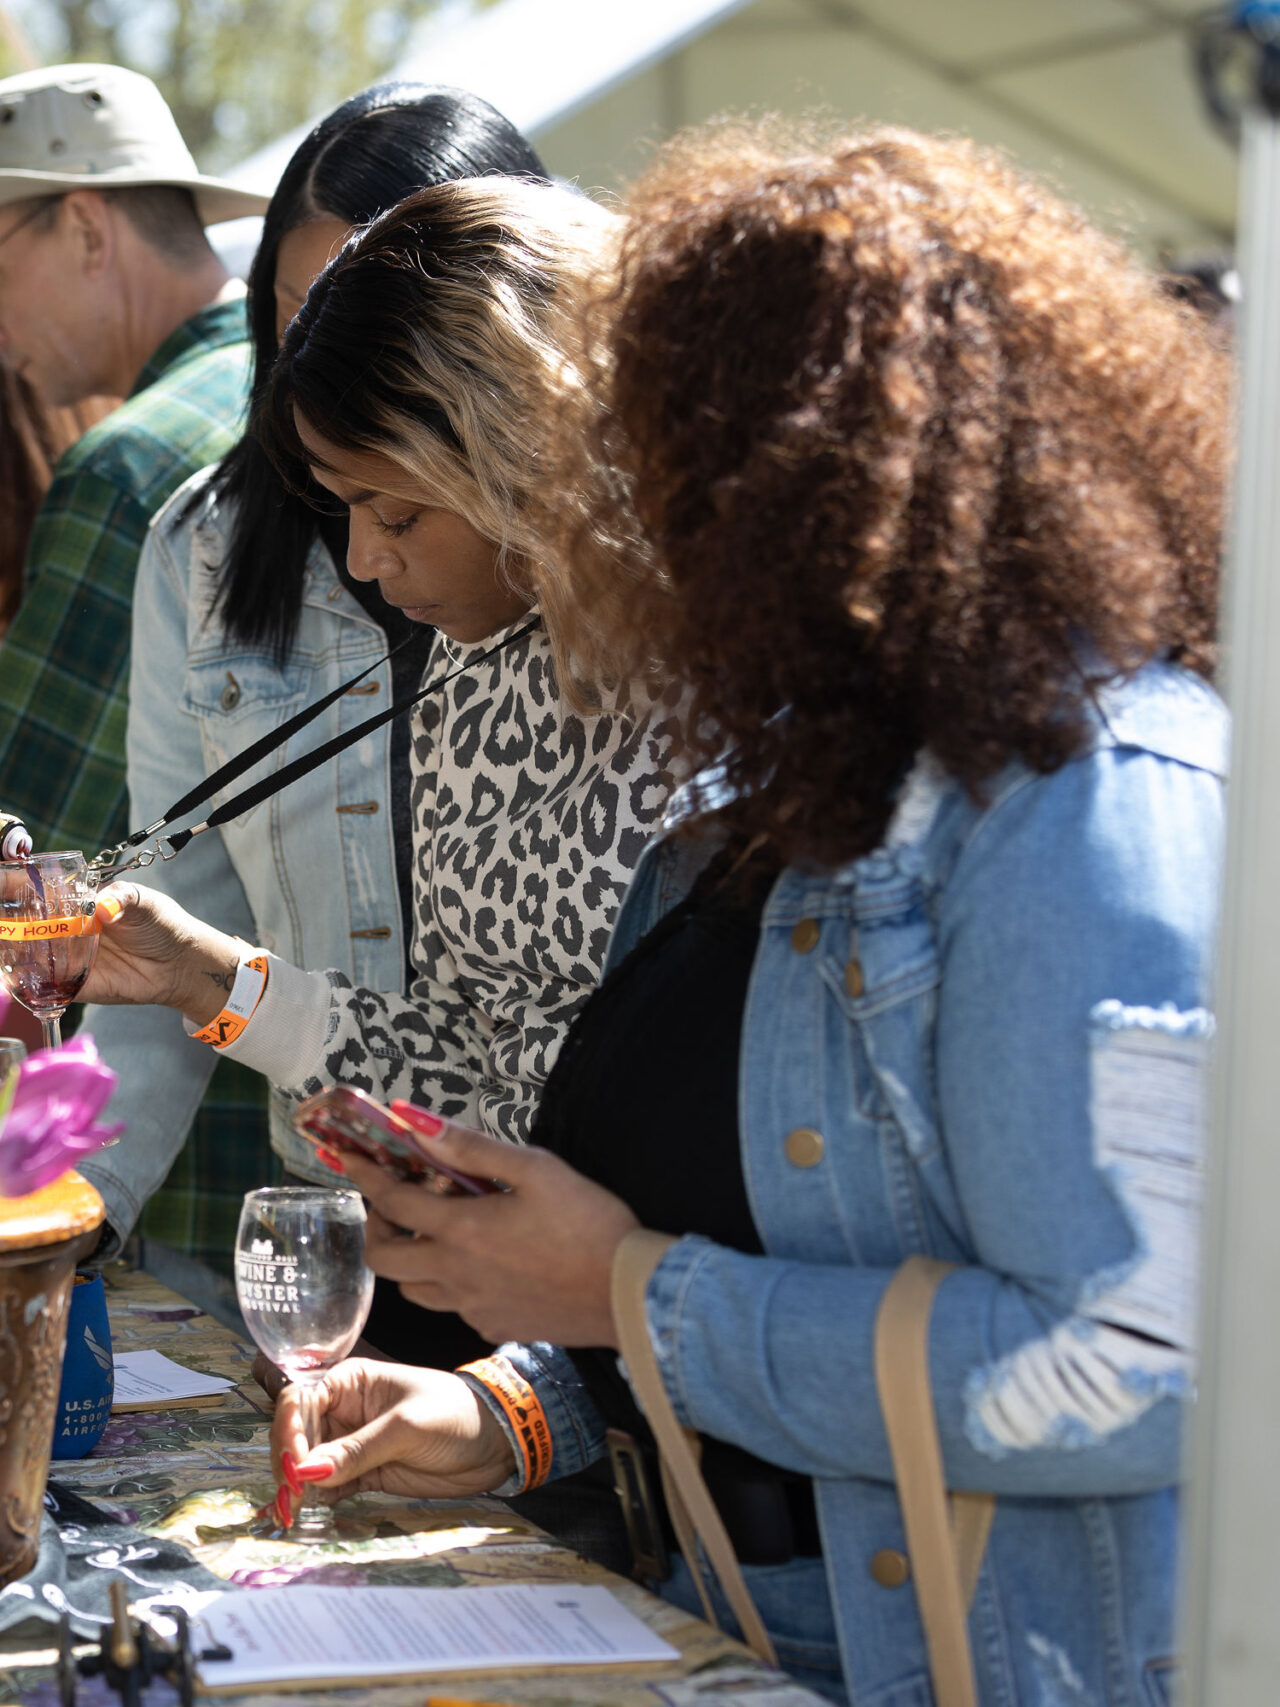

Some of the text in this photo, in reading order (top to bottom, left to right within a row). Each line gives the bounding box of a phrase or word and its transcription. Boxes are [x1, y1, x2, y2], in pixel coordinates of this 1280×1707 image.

[23, 923, 70, 937] HOUR
[283, 1266, 298, 1284] &
[65, 1399, 95, 1412] U.S.
